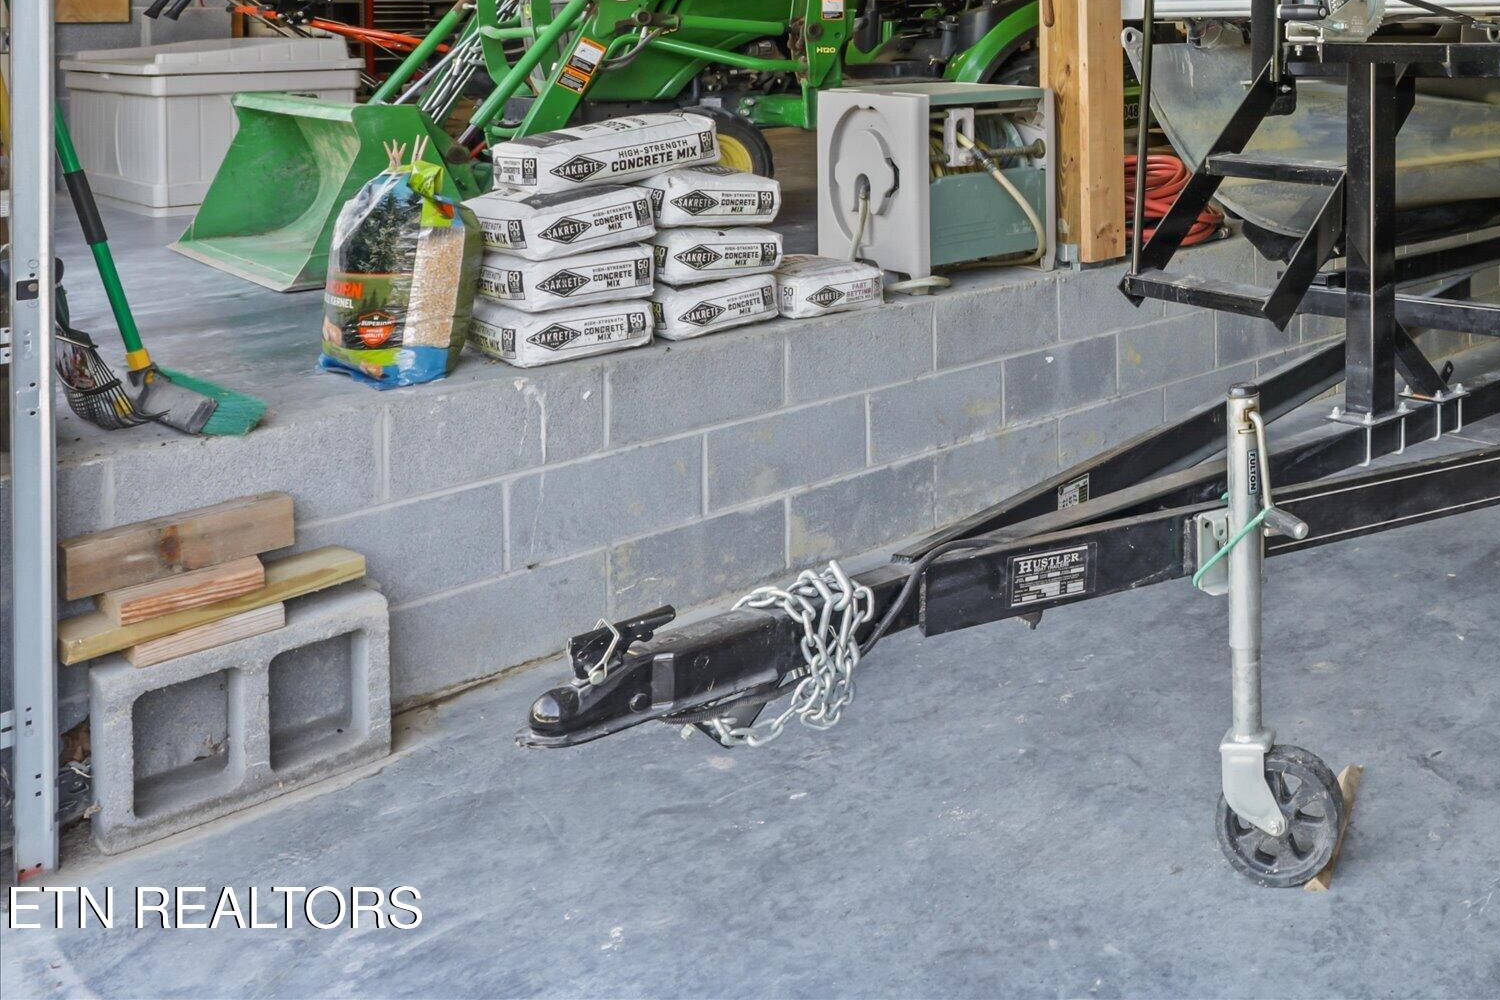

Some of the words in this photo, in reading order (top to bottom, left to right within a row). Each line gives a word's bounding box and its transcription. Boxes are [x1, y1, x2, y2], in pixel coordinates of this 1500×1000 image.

[700, 132, 712, 142] 60
[618, 139, 688, 159] HIGH-STRENGTH
[523, 159, 535, 169] 60
[611, 151, 673, 172] CONCRETE
[676, 146, 697, 160] MIX
[559, 161, 600, 176] SAKRETE
[760, 192, 772, 201] 60
[636, 200, 647, 211] 60
[677, 198, 713, 208] SAKRETE
[721, 199, 756, 207] CONCRETE
[594, 211, 633, 227] CONCRETE
[508, 220, 520, 231] 60
[608, 222, 623, 231] MIX
[546, 223, 585, 239] SAKRETE
[681, 252, 716, 262] SAKRETE
[724, 251, 759, 259] CONCRETE
[637, 259, 648, 269] 60
[508, 271, 520, 281] 60
[592, 270, 632, 282] CONCRETE
[606, 280, 620, 288] MIX
[783, 287, 794, 297] 50
[812, 292, 840, 302] SAKRETE
[727, 297, 761, 311] CONCRETE
[629, 313, 643, 323] 60
[685, 307, 721, 320] SAKRETE
[584, 323, 625, 336] CONCRETE
[503, 330, 513, 340] 60
[534, 329, 574, 343] SAKRETE
[597, 333, 612, 341] MIX
[1249, 452, 1257, 491] FULTON
[1018, 552, 1080, 574] HUSTLER
